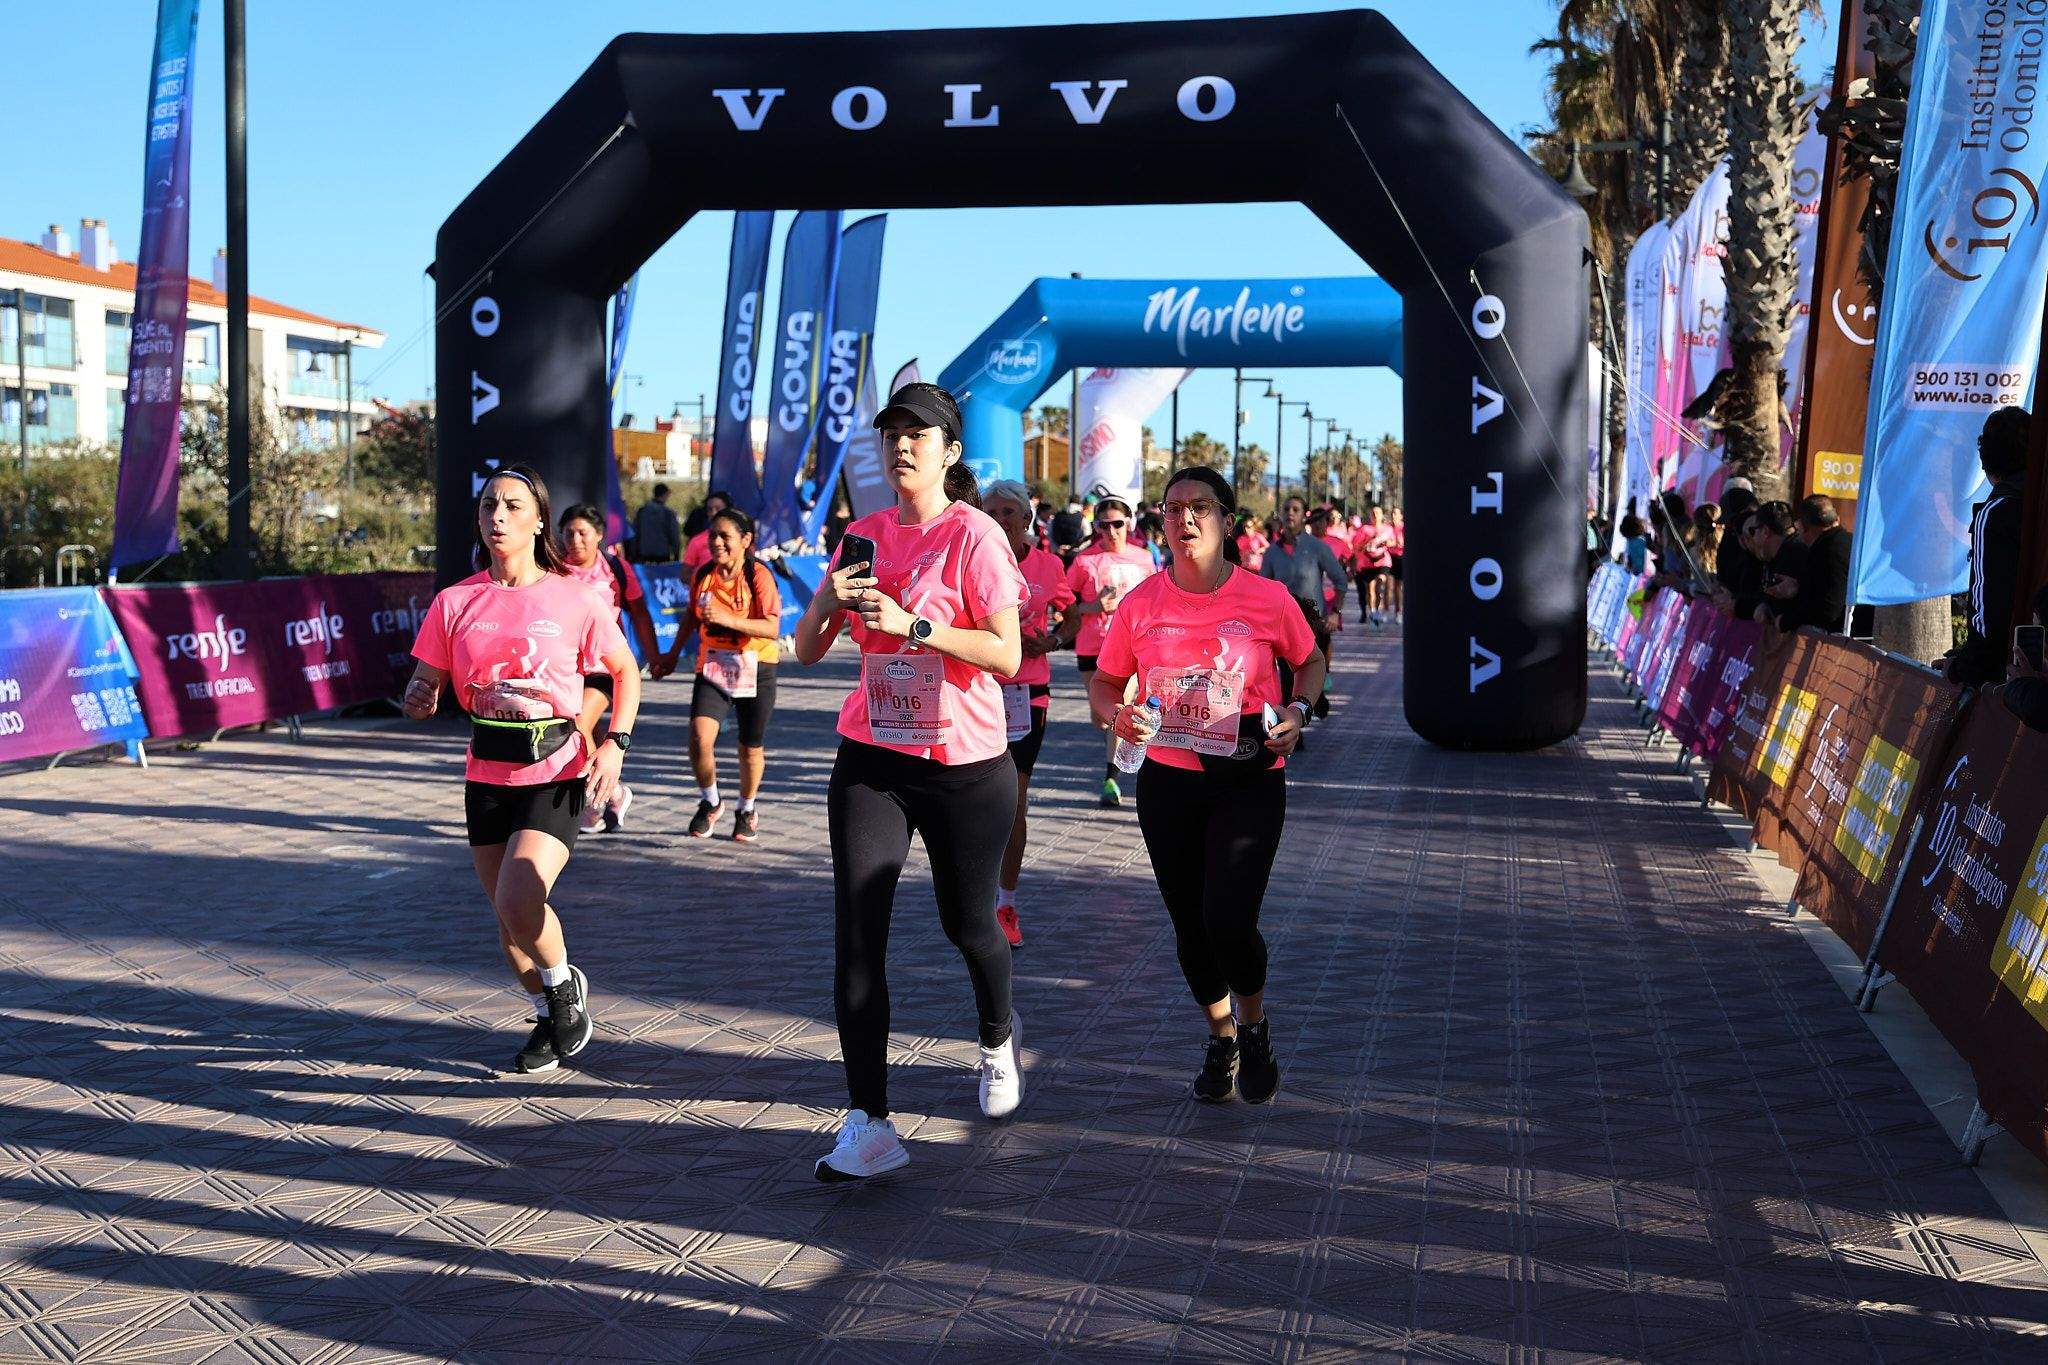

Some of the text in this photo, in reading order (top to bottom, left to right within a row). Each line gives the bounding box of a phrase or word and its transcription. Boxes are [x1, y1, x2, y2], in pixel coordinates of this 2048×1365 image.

[712, 75, 1236, 131] VOLVO
[1143, 286, 1306, 357] Marlene
[778, 310, 814, 432] GOYA
[825, 329, 858, 443] GOYA
[1914, 388, 2018, 405] www.ioa.es
[1916, 371, 2022, 388] 900 131 002
[1469, 294, 1506, 693] VOLVO
[1822, 459, 1855, 475] 900
[166, 613, 247, 672] renfe
[285, 600, 344, 656] renfe
[214, 677, 256, 698] OFICIAL
[892, 695, 922, 710] 016
[1179, 703, 1211, 721] 016
[1157, 735, 1186, 744] OYSHO
[1962, 792, 2006, 847] Institutos
[1948, 835, 2008, 910] Odontológicos
